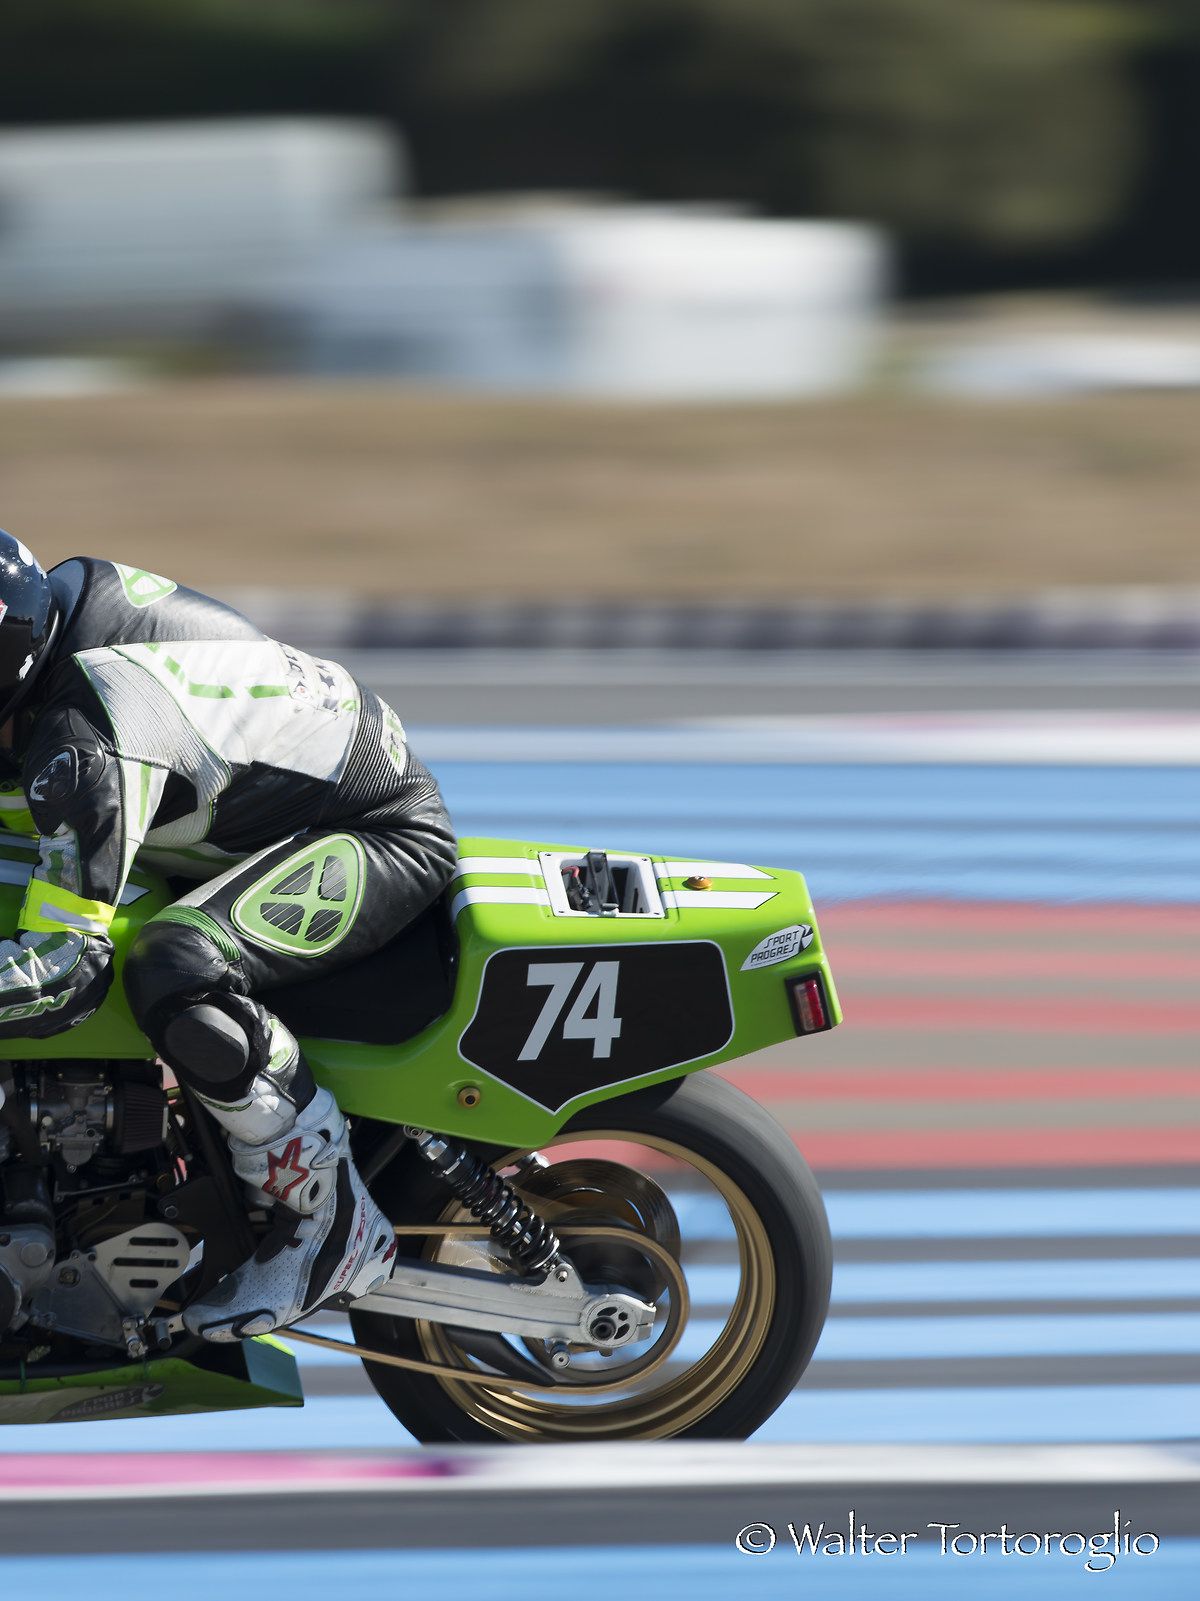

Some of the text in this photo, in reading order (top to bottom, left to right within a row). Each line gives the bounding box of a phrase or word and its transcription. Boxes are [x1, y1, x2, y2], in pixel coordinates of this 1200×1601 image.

[764, 930, 800, 949] SPORT
[750, 941, 799, 963] PROGRES
[517, 960, 622, 1061] 74
